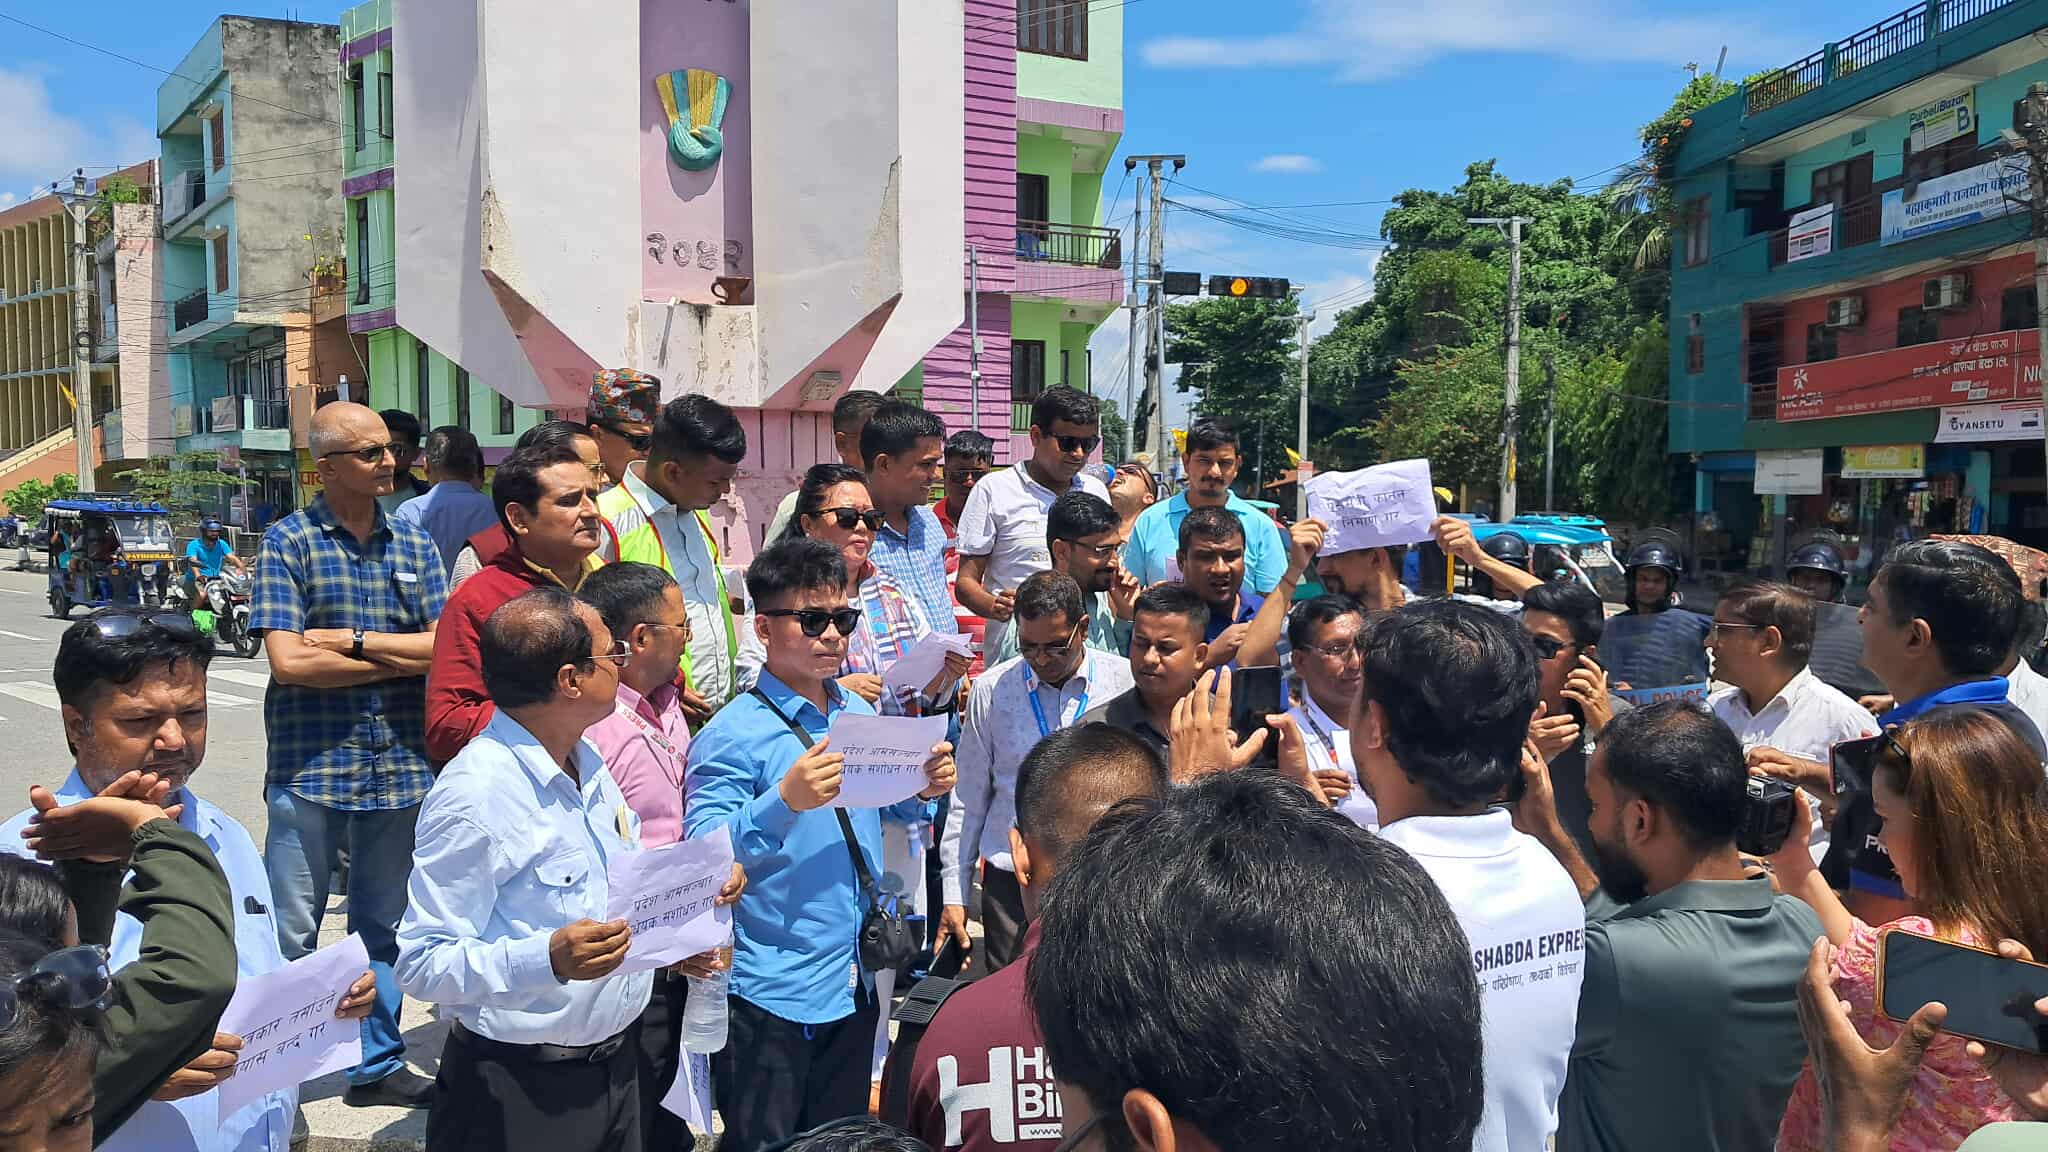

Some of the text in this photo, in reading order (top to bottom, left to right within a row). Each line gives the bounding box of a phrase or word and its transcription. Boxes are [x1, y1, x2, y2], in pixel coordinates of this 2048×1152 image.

[1957, 106, 1970, 133] B
[1951, 419, 2004, 431] GYANSETU
[1474, 938, 1534, 973] SHABDA
[1030, 1128, 1062, 1136] www
